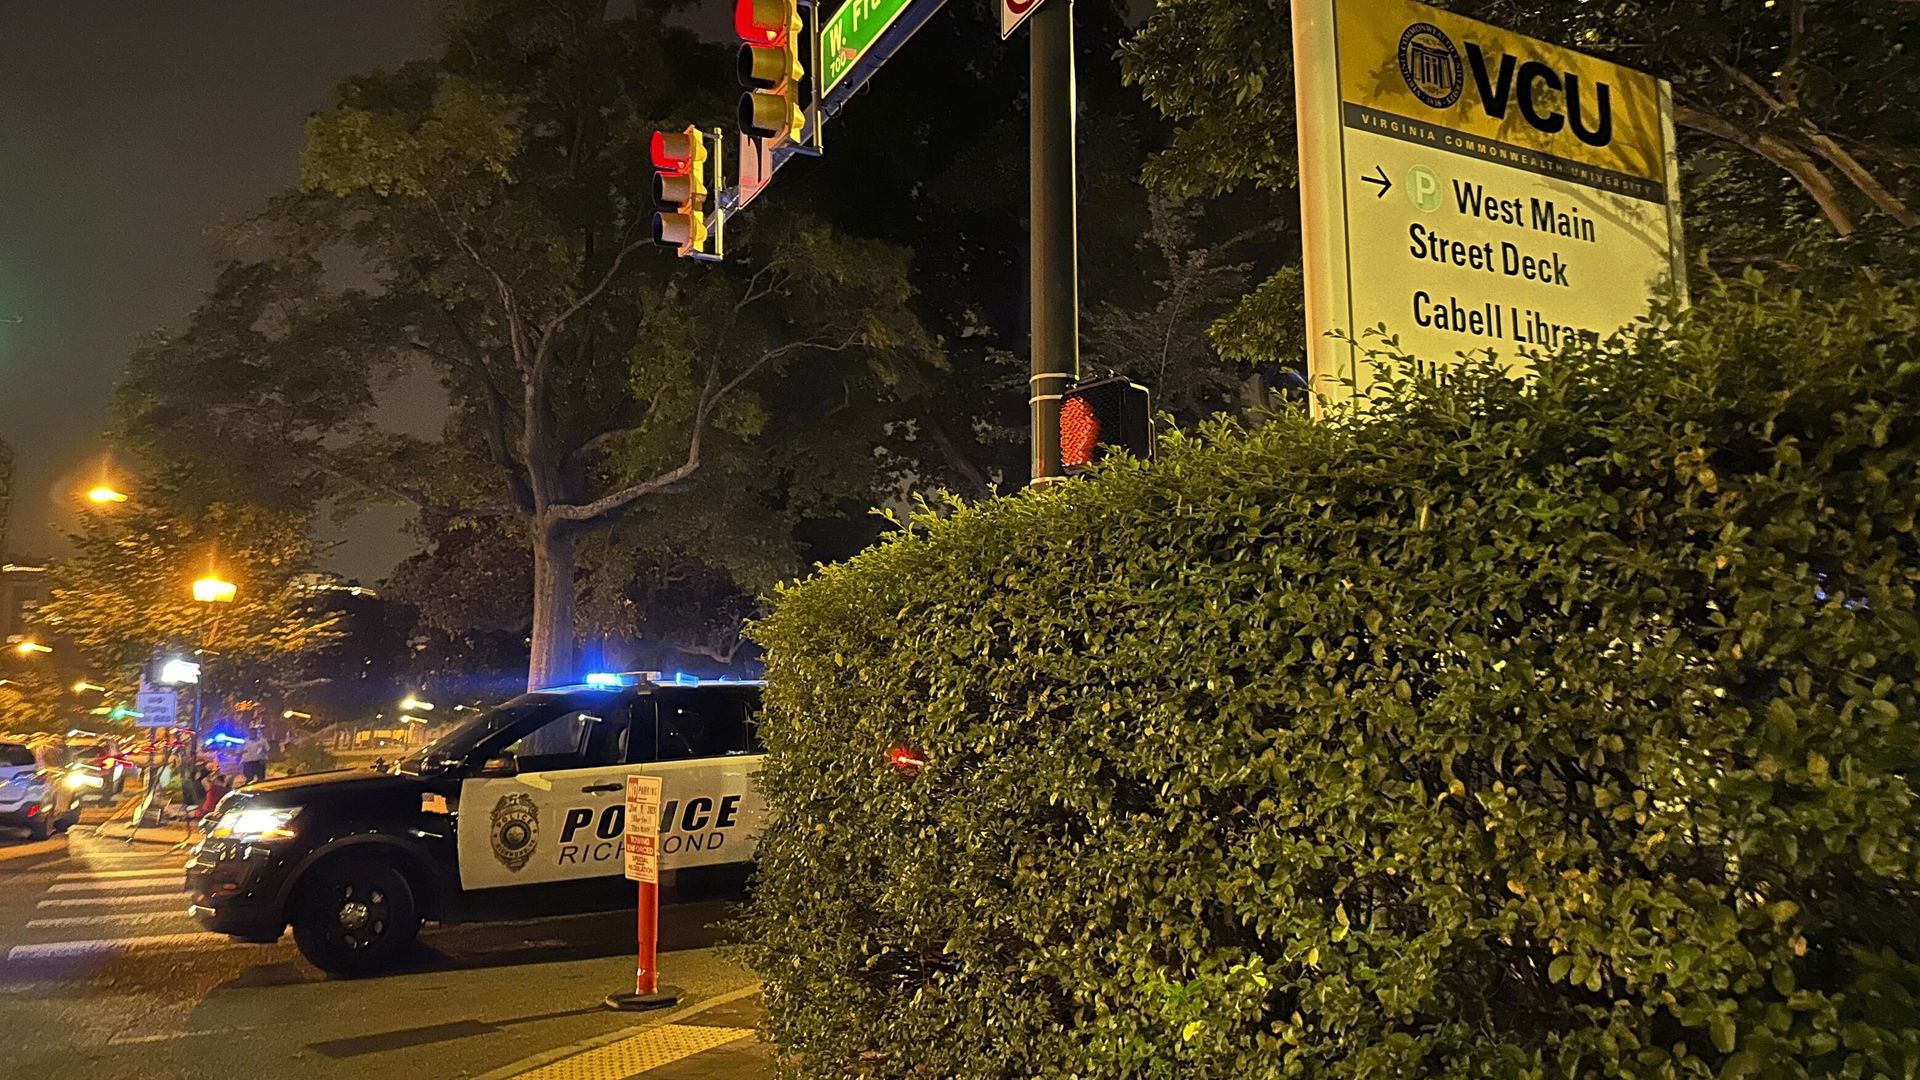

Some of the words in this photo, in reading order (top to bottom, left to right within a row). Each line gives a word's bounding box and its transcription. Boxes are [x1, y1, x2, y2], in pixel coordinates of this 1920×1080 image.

[829, 18, 847, 57] W.
[830, 50, 847, 78] 700
[1463, 40, 1612, 148] VCU
[1361, 113, 1435, 141] VIRGINIA
[1444, 135, 1563, 173] COMMONWEALTH
[1571, 166, 1651, 195] UNIVERSITY
[1415, 170, 1436, 206] P
[1452, 178, 1524, 227] West
[1530, 197, 1596, 242] Main
[1409, 222, 1495, 273] Street
[1501, 241, 1569, 287] Deck
[1413, 290, 1502, 339] Cabell
[559, 795, 742, 843] POICE
[558, 832, 725, 866] RICHOND
